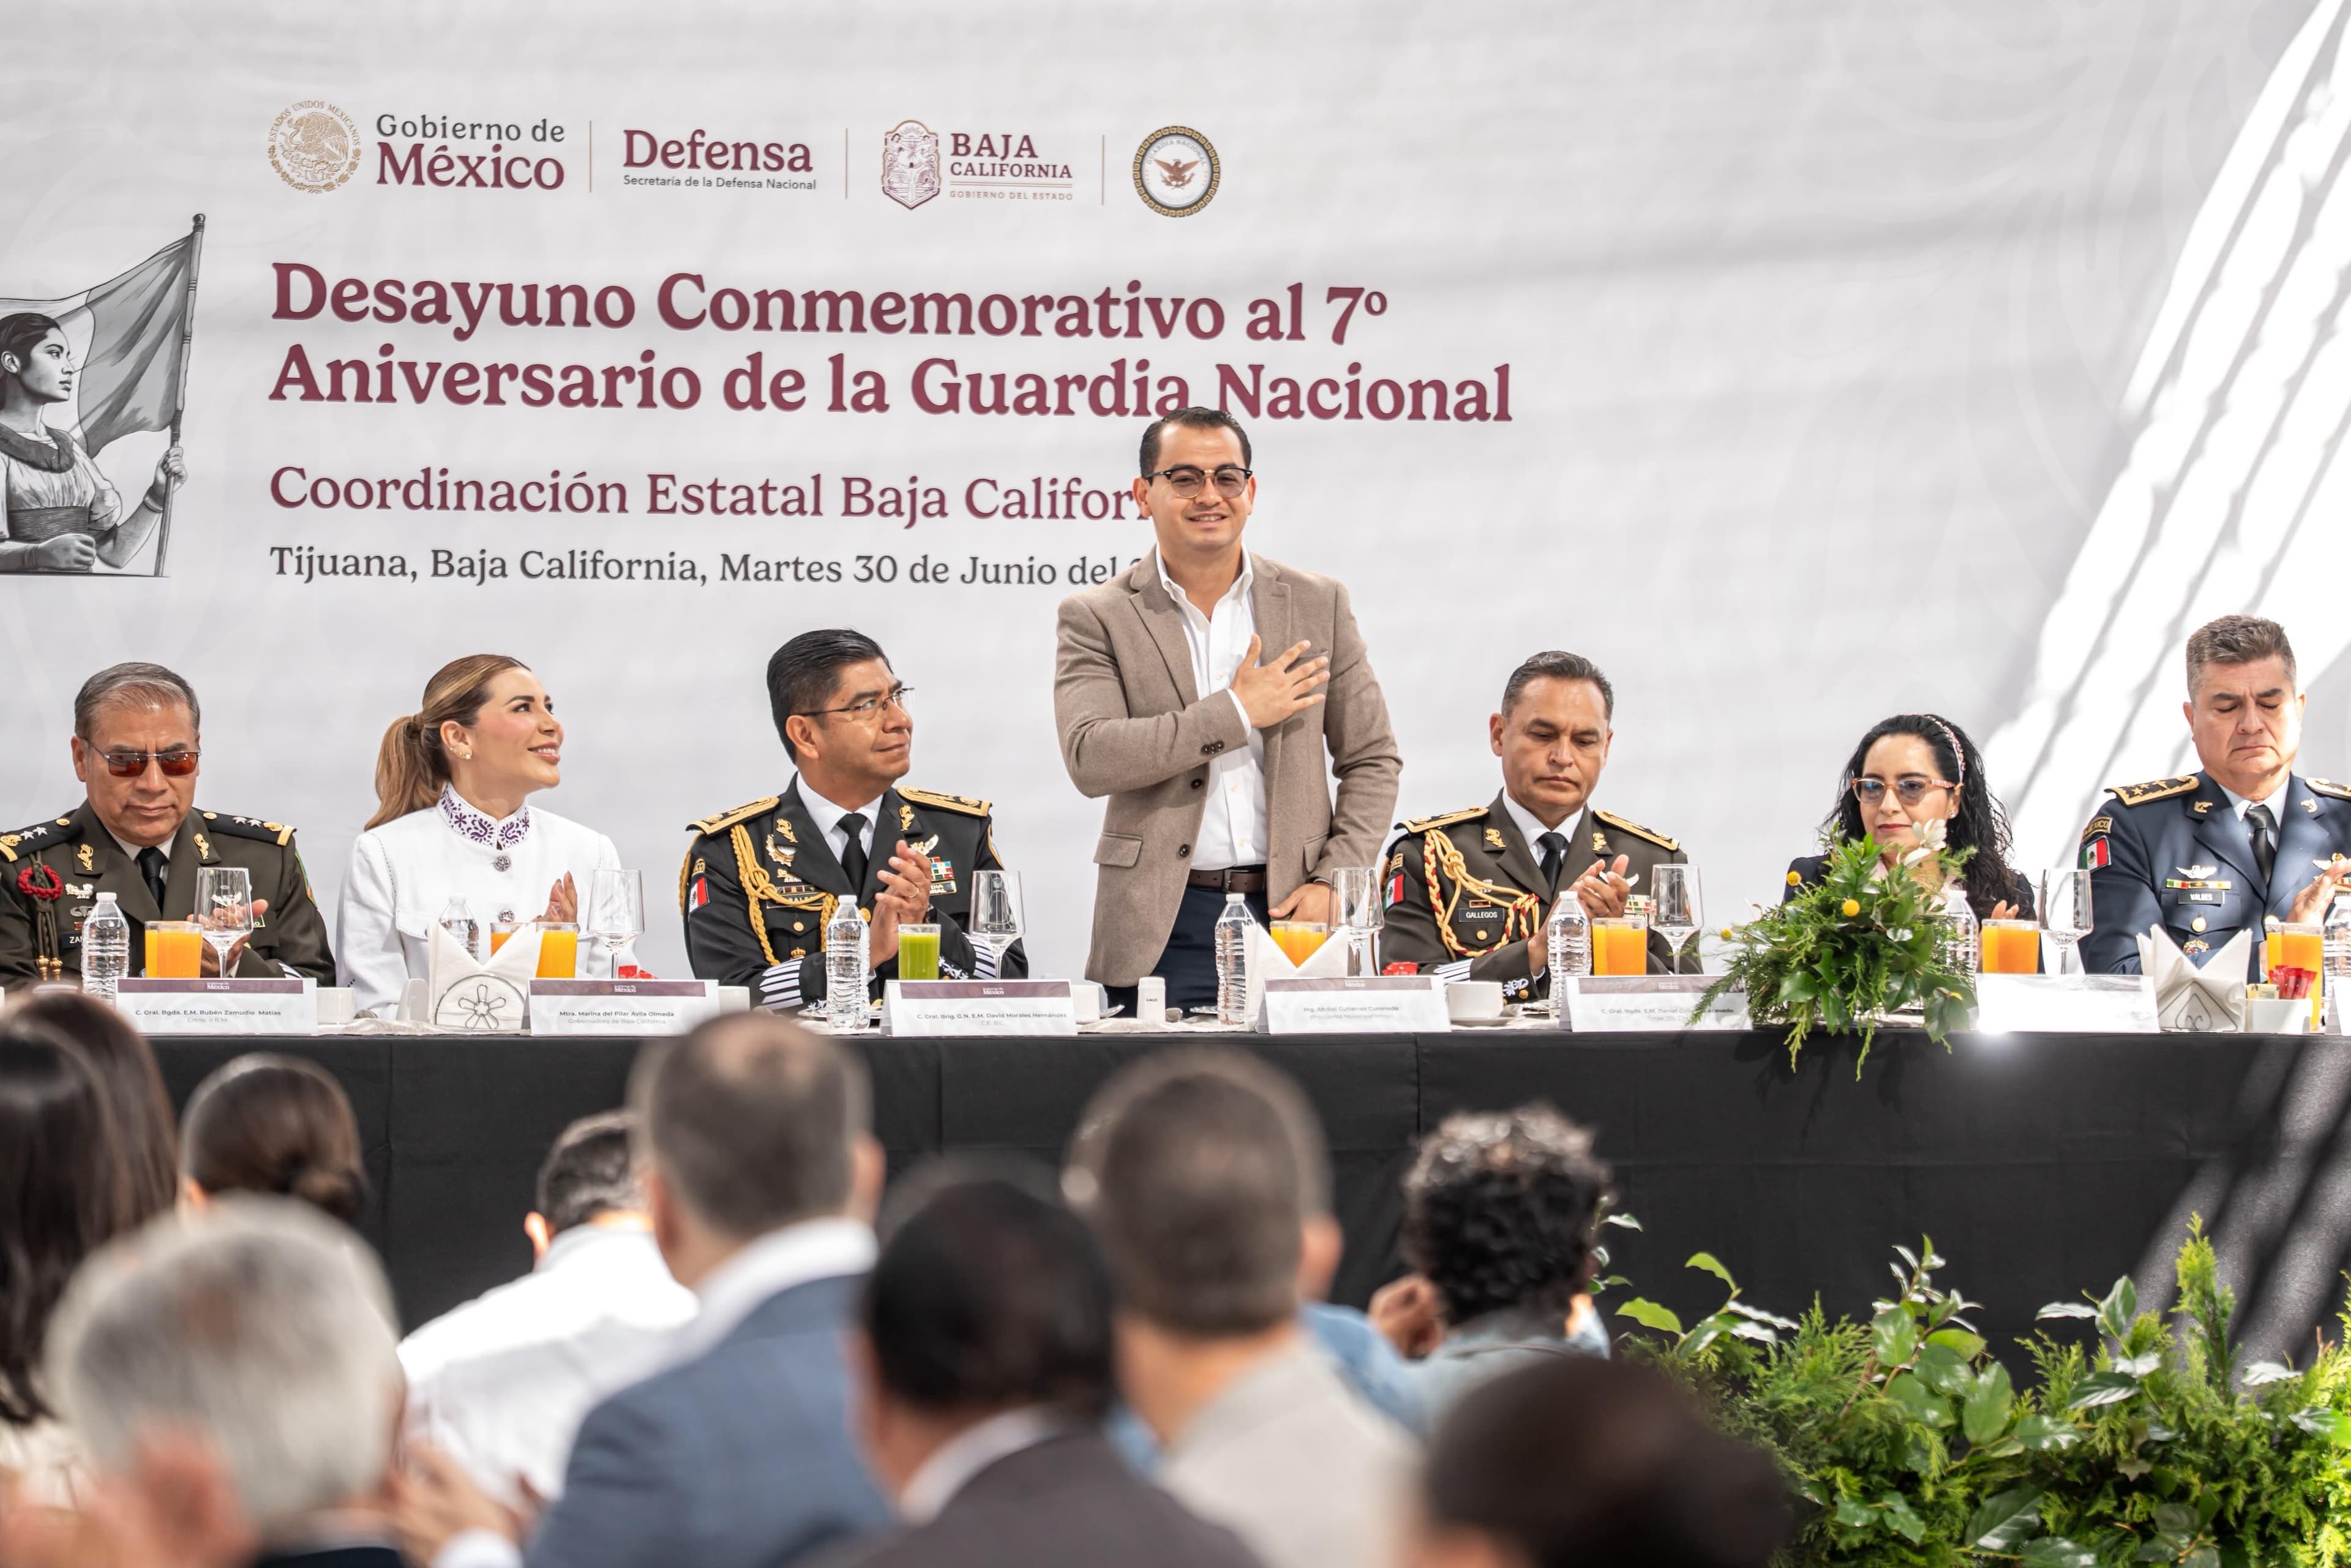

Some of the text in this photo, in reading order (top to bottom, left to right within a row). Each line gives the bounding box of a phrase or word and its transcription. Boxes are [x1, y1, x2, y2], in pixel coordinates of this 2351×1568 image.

[268, 100, 362, 146] ESTADOS UNIDOS MEXICANOS
[376, 114, 565, 143] Gobierno de
[376, 142, 565, 190] México
[623, 129, 814, 173] Defensa
[950, 133, 1039, 162] BAJA
[623, 175, 816, 190] Secretaría de la Defensa Nacional
[950, 162, 1073, 179] CALIFORNIA
[950, 190, 1073, 201] GOBIERNO DEL ESTADO
[271, 262, 636, 342] Desayuno
[657, 272, 1225, 341] Conmemorativo
[1246, 282, 1306, 341] al
[268, 343, 1513, 422] Aniversario de la Guardia Nacional
[270, 466, 629, 514] Coordinación
[646, 473, 823, 517] Estatal
[841, 476, 949, 530] Baja
[270, 546, 1117, 587] Tijuana, Baja California, Martes 30 de Junio del
